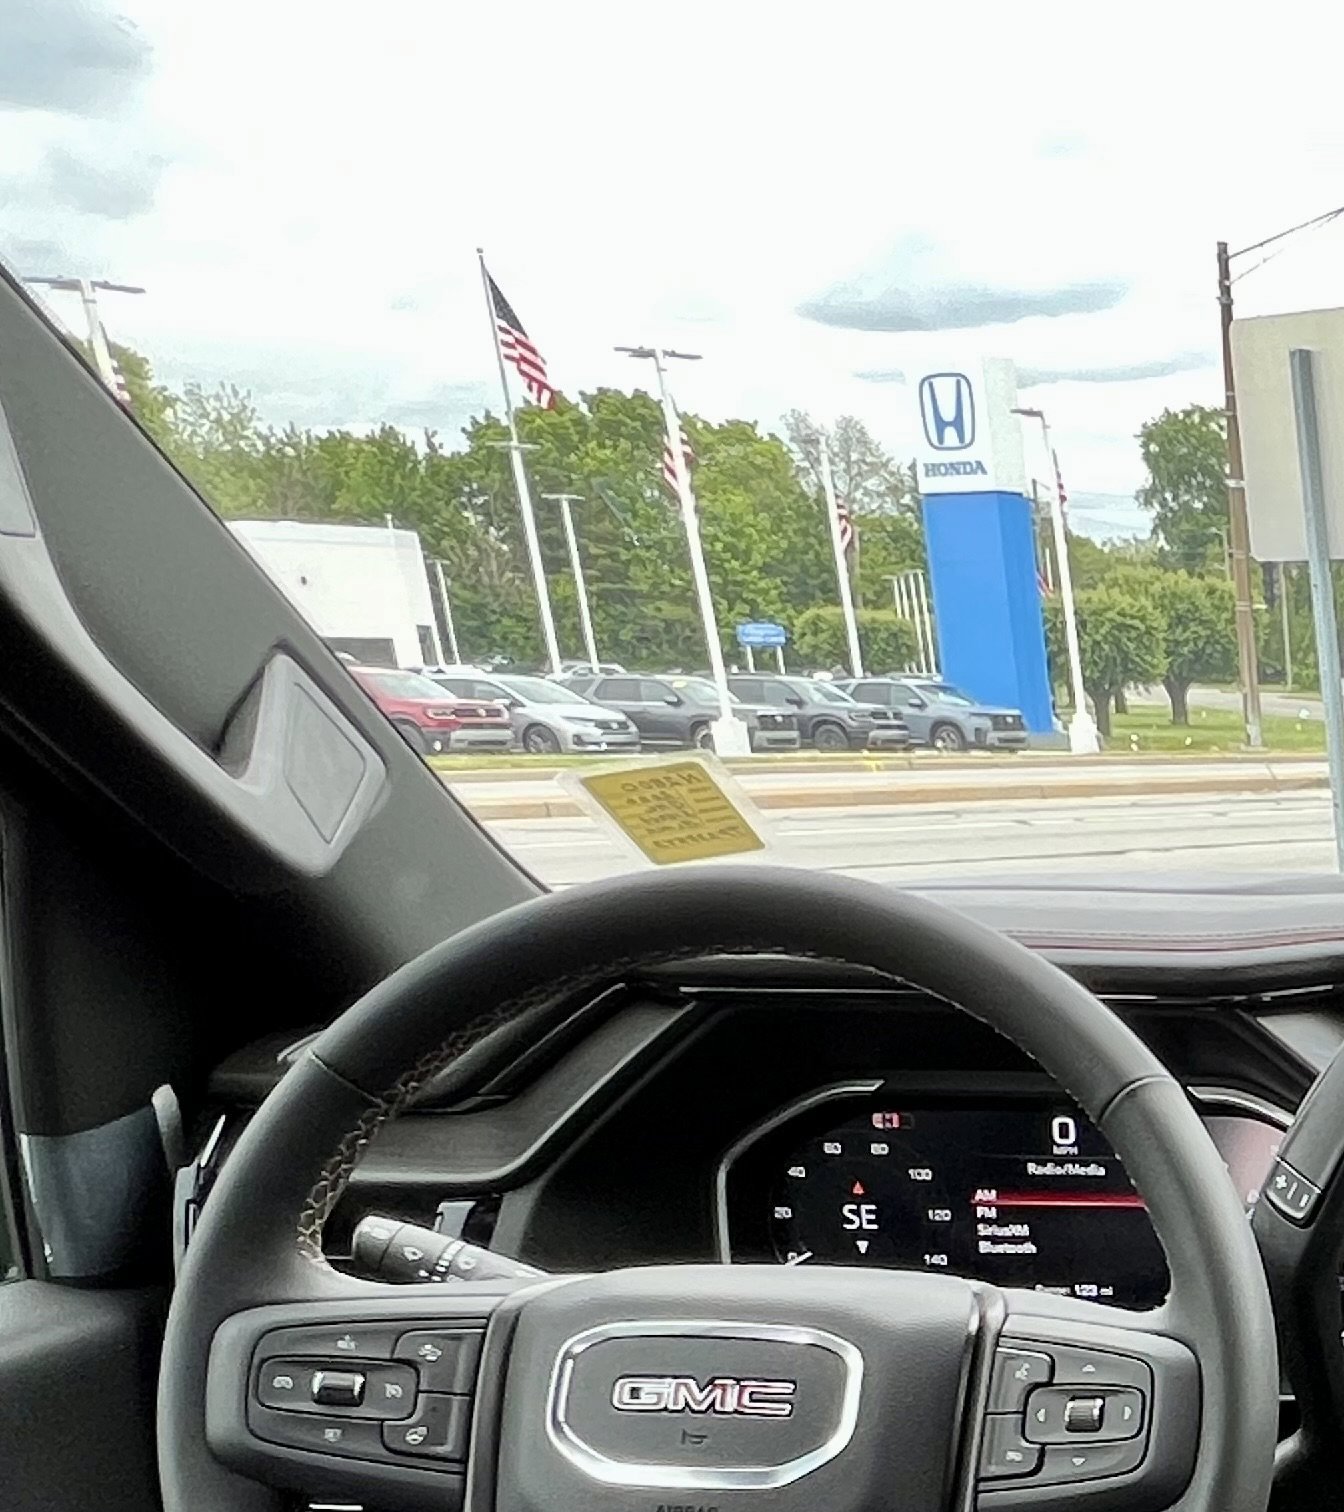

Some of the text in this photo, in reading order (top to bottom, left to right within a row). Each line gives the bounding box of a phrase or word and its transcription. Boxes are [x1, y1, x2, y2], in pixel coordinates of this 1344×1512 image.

[922, 460, 988, 478] HONDA
[1052, 1116, 1077, 1146] 0
[823, 1142, 889, 1156] 60 80
[787, 1166, 806, 1178] 40
[908, 1168, 933, 1181] 100
[1026, 1162, 1107, 1176] Radio/Media
[974, 1189, 998, 1201] AM
[774, 1206, 792, 1219] 20
[842, 1204, 879, 1230] SE
[928, 1209, 952, 1222] 120
[976, 1206, 998, 1220] FM
[976, 1222, 1030, 1237] SiriusXM
[978, 1240, 1038, 1254] Bluetooth
[923, 1254, 948, 1266] 140
[611, 1374, 798, 1418] GMC
